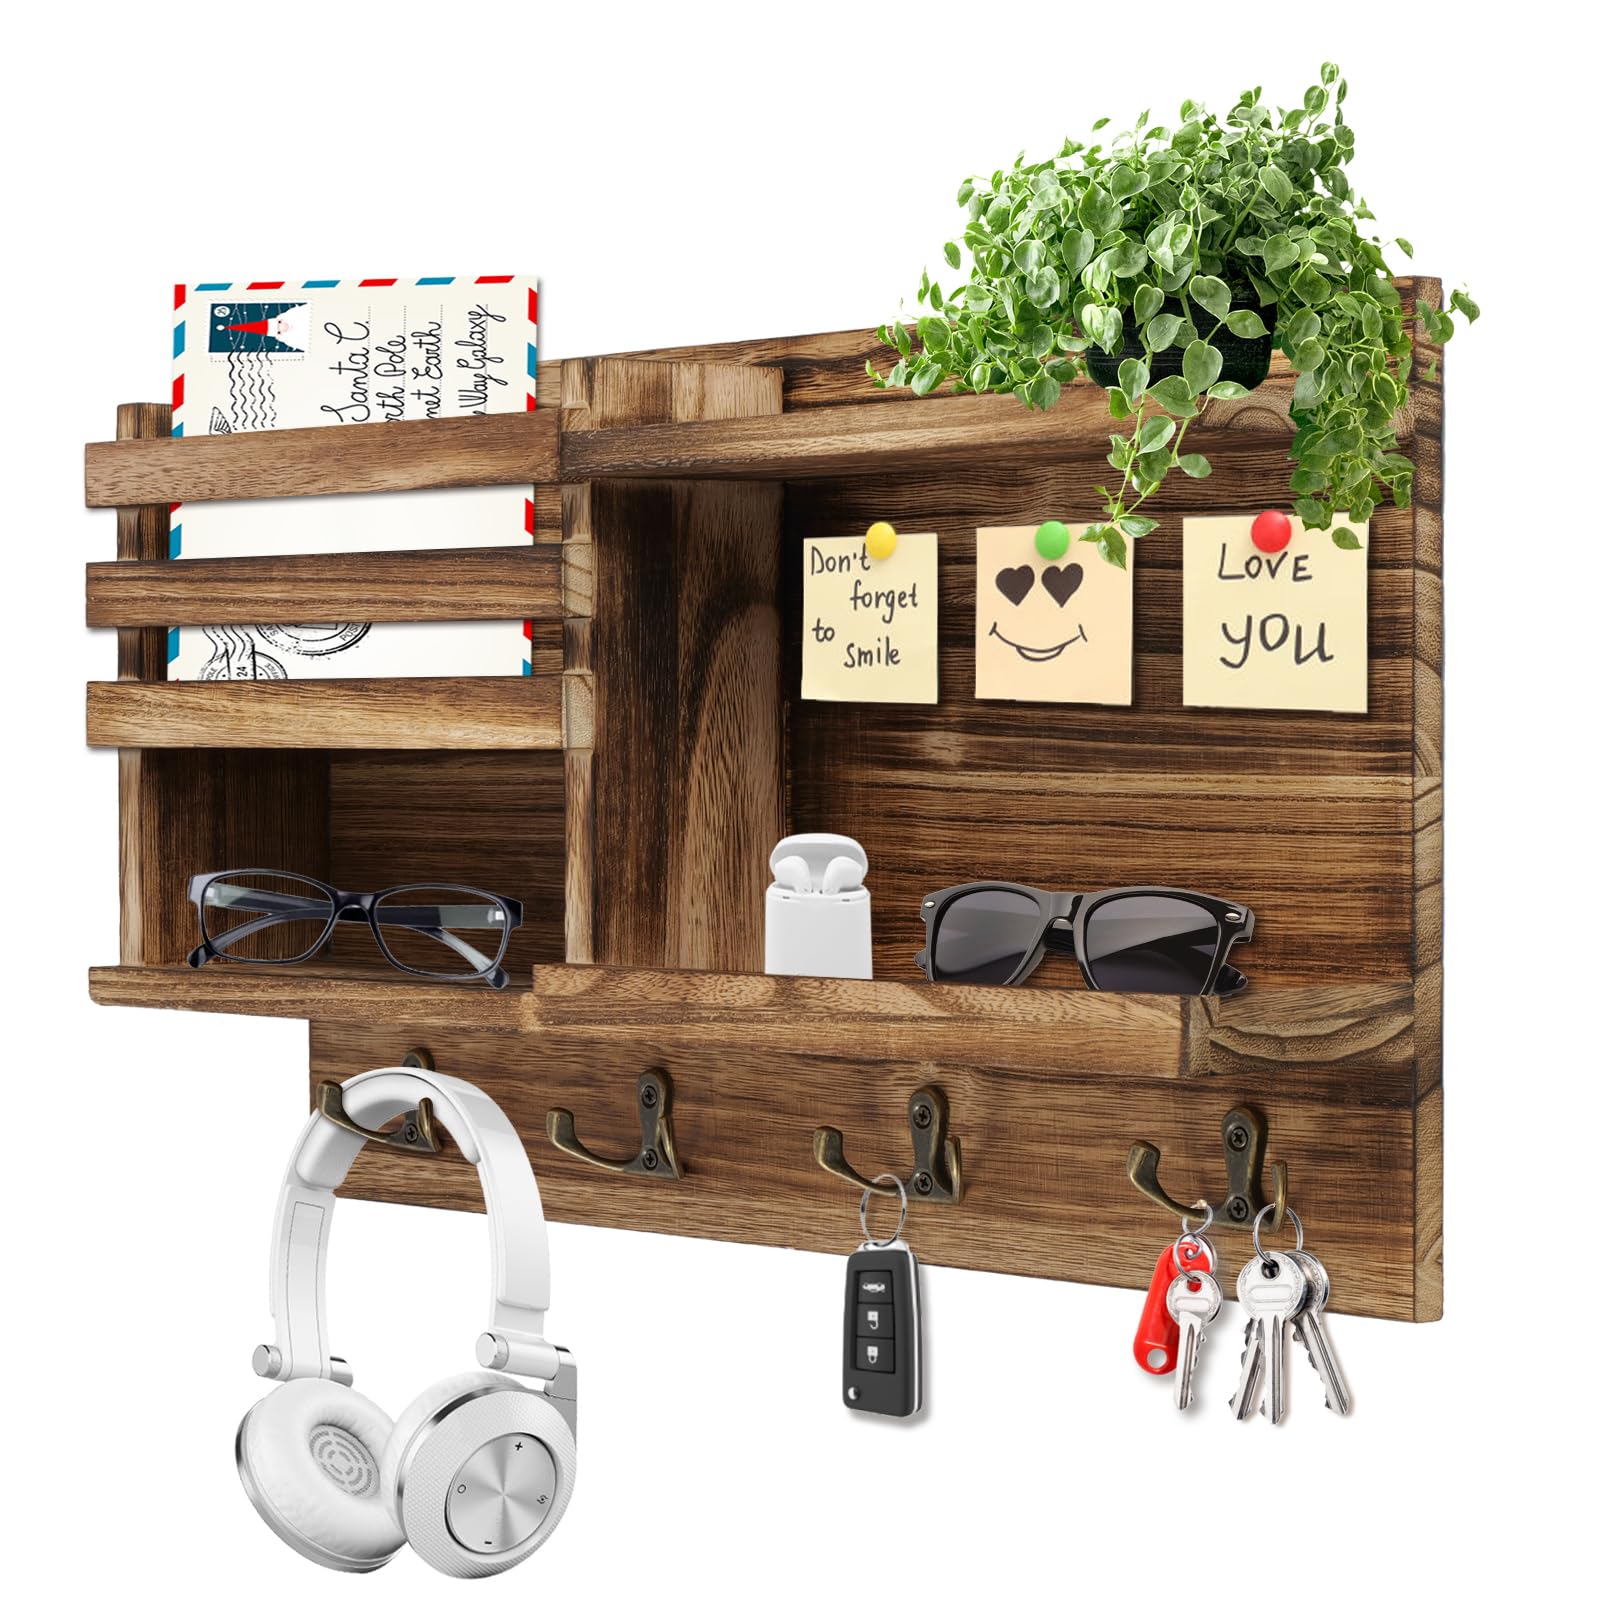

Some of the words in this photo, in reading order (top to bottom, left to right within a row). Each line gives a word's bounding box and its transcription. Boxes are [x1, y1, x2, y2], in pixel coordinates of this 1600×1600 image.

[373, 335, 407, 377] Pole
[411, 321, 443, 380] Earth
[455, 304, 507, 369] Galaxy
[320, 347, 370, 422] Santa
[811, 543, 871, 575] Don't
[850, 579, 918, 624] forget
[812, 618, 836, 642] to
[236, 666, 248, 677] 24
